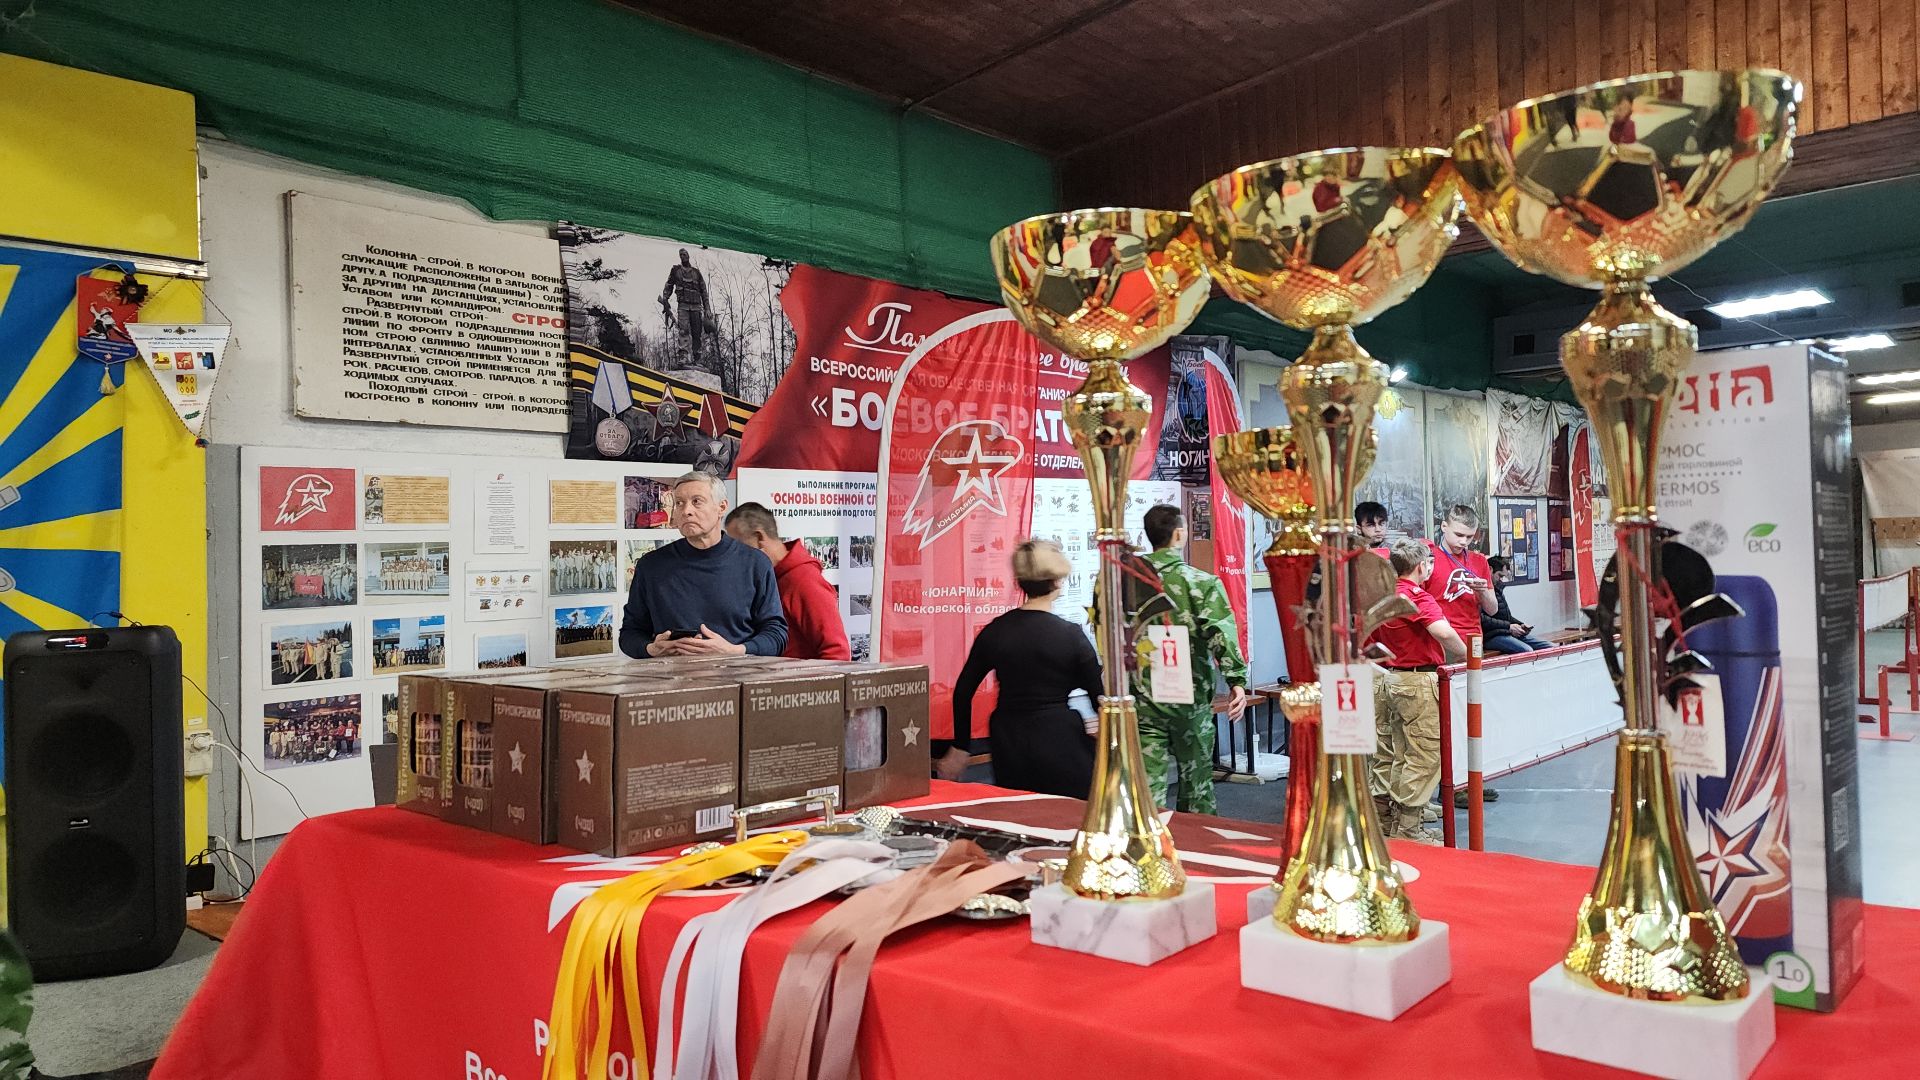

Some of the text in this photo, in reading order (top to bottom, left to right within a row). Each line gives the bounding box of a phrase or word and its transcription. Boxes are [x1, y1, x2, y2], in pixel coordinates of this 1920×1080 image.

[366, 244, 417, 260] КОЛОННА
[478, 265, 525, 278] КОТОРОМ
[342, 254, 408, 270] СЛУЖАЩИЕ
[414, 265, 490, 282] РАСПОЛОЖЕНЫ
[505, 280, 549, 291] ЗАТЫЛОК
[342, 275, 357, 283] ЗА
[363, 278, 406, 290] ДРУГИМ
[413, 285, 427, 293] НА
[393, 272, 476, 290] ПОДРАЗДЕЛЕНИЯ
[478, 283, 531, 300] (МАШИНЫ)
[401, 294, 422, 302] ИЛИ
[430, 298, 505, 313] КОМАНДИРОМ.
[343, 317, 379, 328] ЛИНИИ
[387, 322, 402, 330] ПО
[409, 326, 452, 336] ФРОНТУ
[397, 314, 447, 326] КОТОРОМ
[456, 321, 535, 336] ПОДРАЗДЕЛЕНИЯ
[512, 313, 569, 328] СТРО
[343, 328, 368, 337] НОМ
[376, 332, 416, 342] СТРОЮ
[522, 348, 540, 356] ИЛИ
[420, 347, 502, 361] УСТАНОВЛЕННЫХ
[426, 358, 460, 367] СТРОЙ
[467, 362, 530, 373] ПРИМЕНЯЕТСЯ
[344, 370, 399, 381] ХОДИМЫХ
[344, 391, 410, 403] ПОСТРОЕНО
[432, 399, 478, 408] КОЛОННУ
[433, 389, 467, 398] СТРОЙ
[821, 492, 864, 505] ВОЕННОЙ
[788, 508, 841, 517] ДОПРИЗЫВНОЙ
[937, 495, 976, 529] ЮНАРМИЯ
[1749, 539, 1781, 552] eco
[922, 586, 1000, 598] «ЮНАРМИЯ»
[894, 602, 970, 614] Московской
[852, 681, 927, 701] ТЕРМОКРУЖКА
[750, 690, 840, 712] ТЕРМОКРУЖКА
[494, 703, 541, 719] ТЕРМОКРУЖКА
[559, 709, 610, 726] ТЕРМОКРУЖКА
[628, 700, 735, 726] ТЕРМОКРУЖКА
